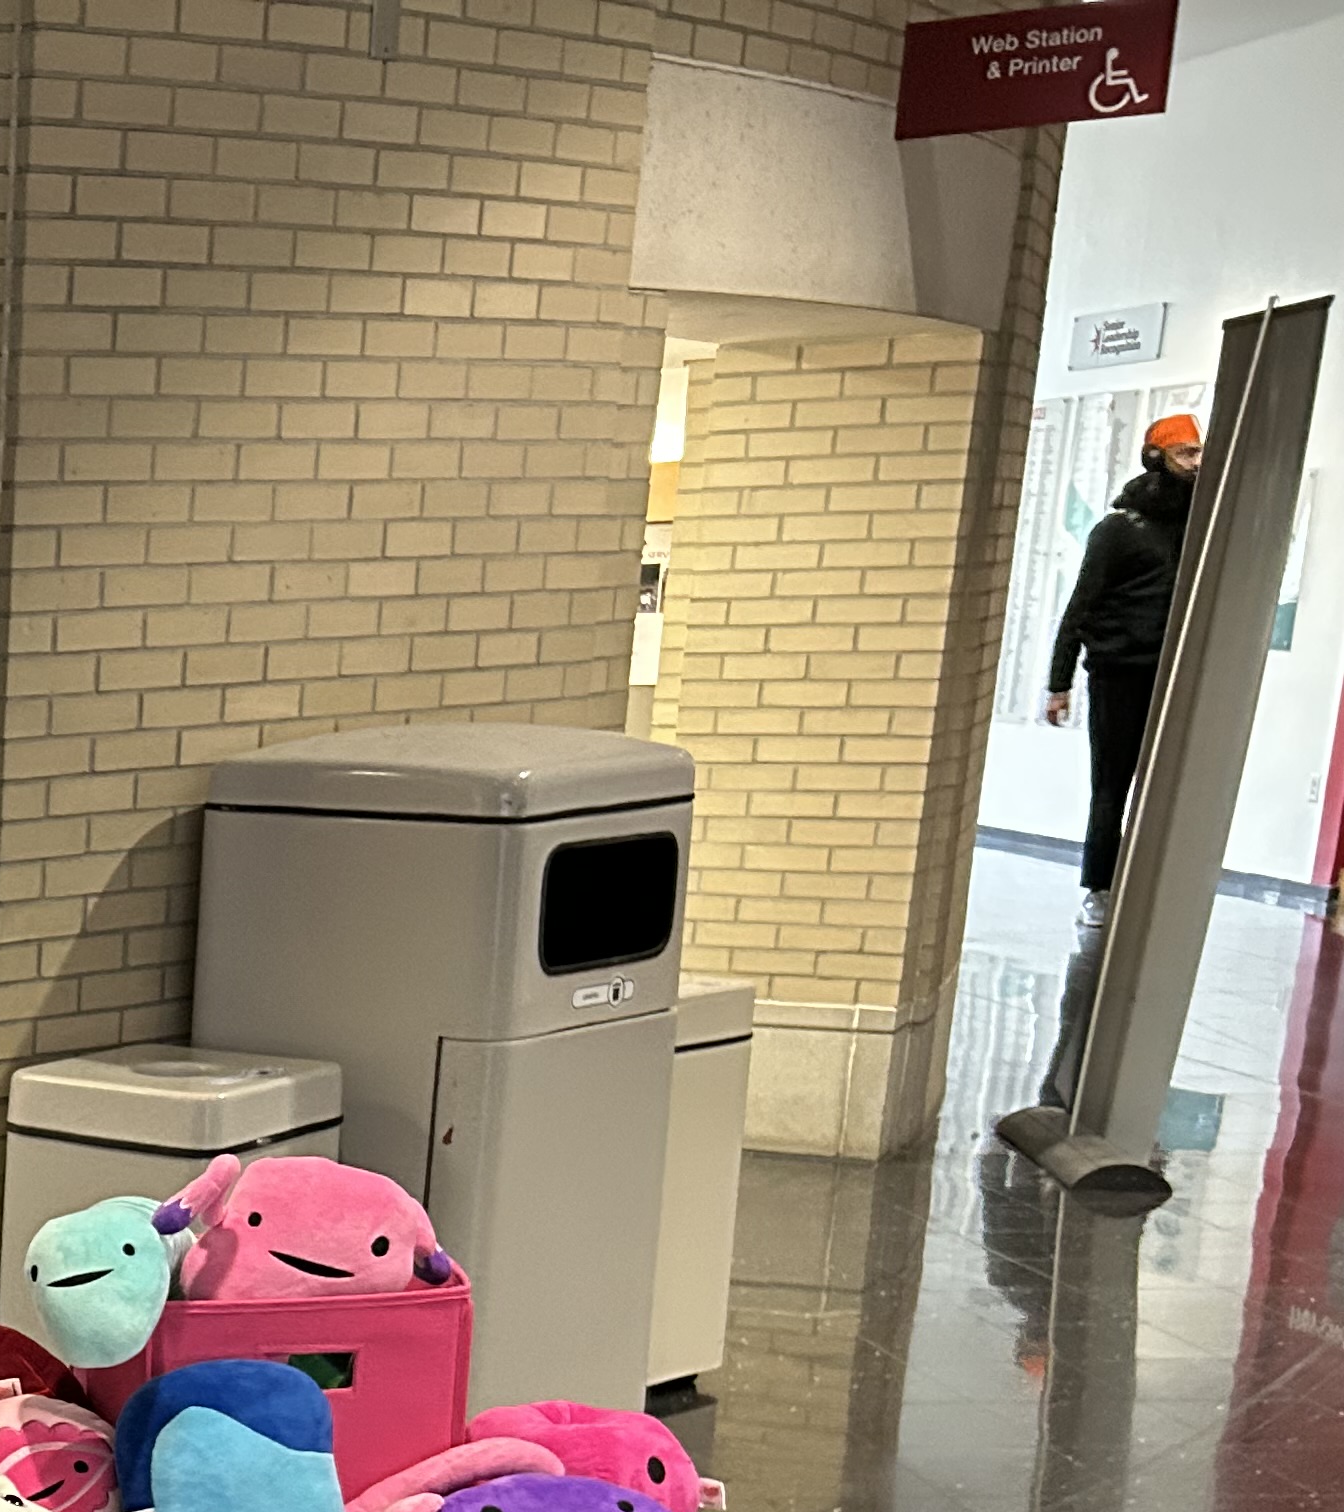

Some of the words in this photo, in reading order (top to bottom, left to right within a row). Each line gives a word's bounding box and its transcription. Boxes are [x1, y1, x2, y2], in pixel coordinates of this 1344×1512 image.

[971, 34, 1019, 55] Web
[1025, 26, 1103, 49] Station
[986, 61, 1001, 80] &
[1008, 56, 1083, 77] Printer
